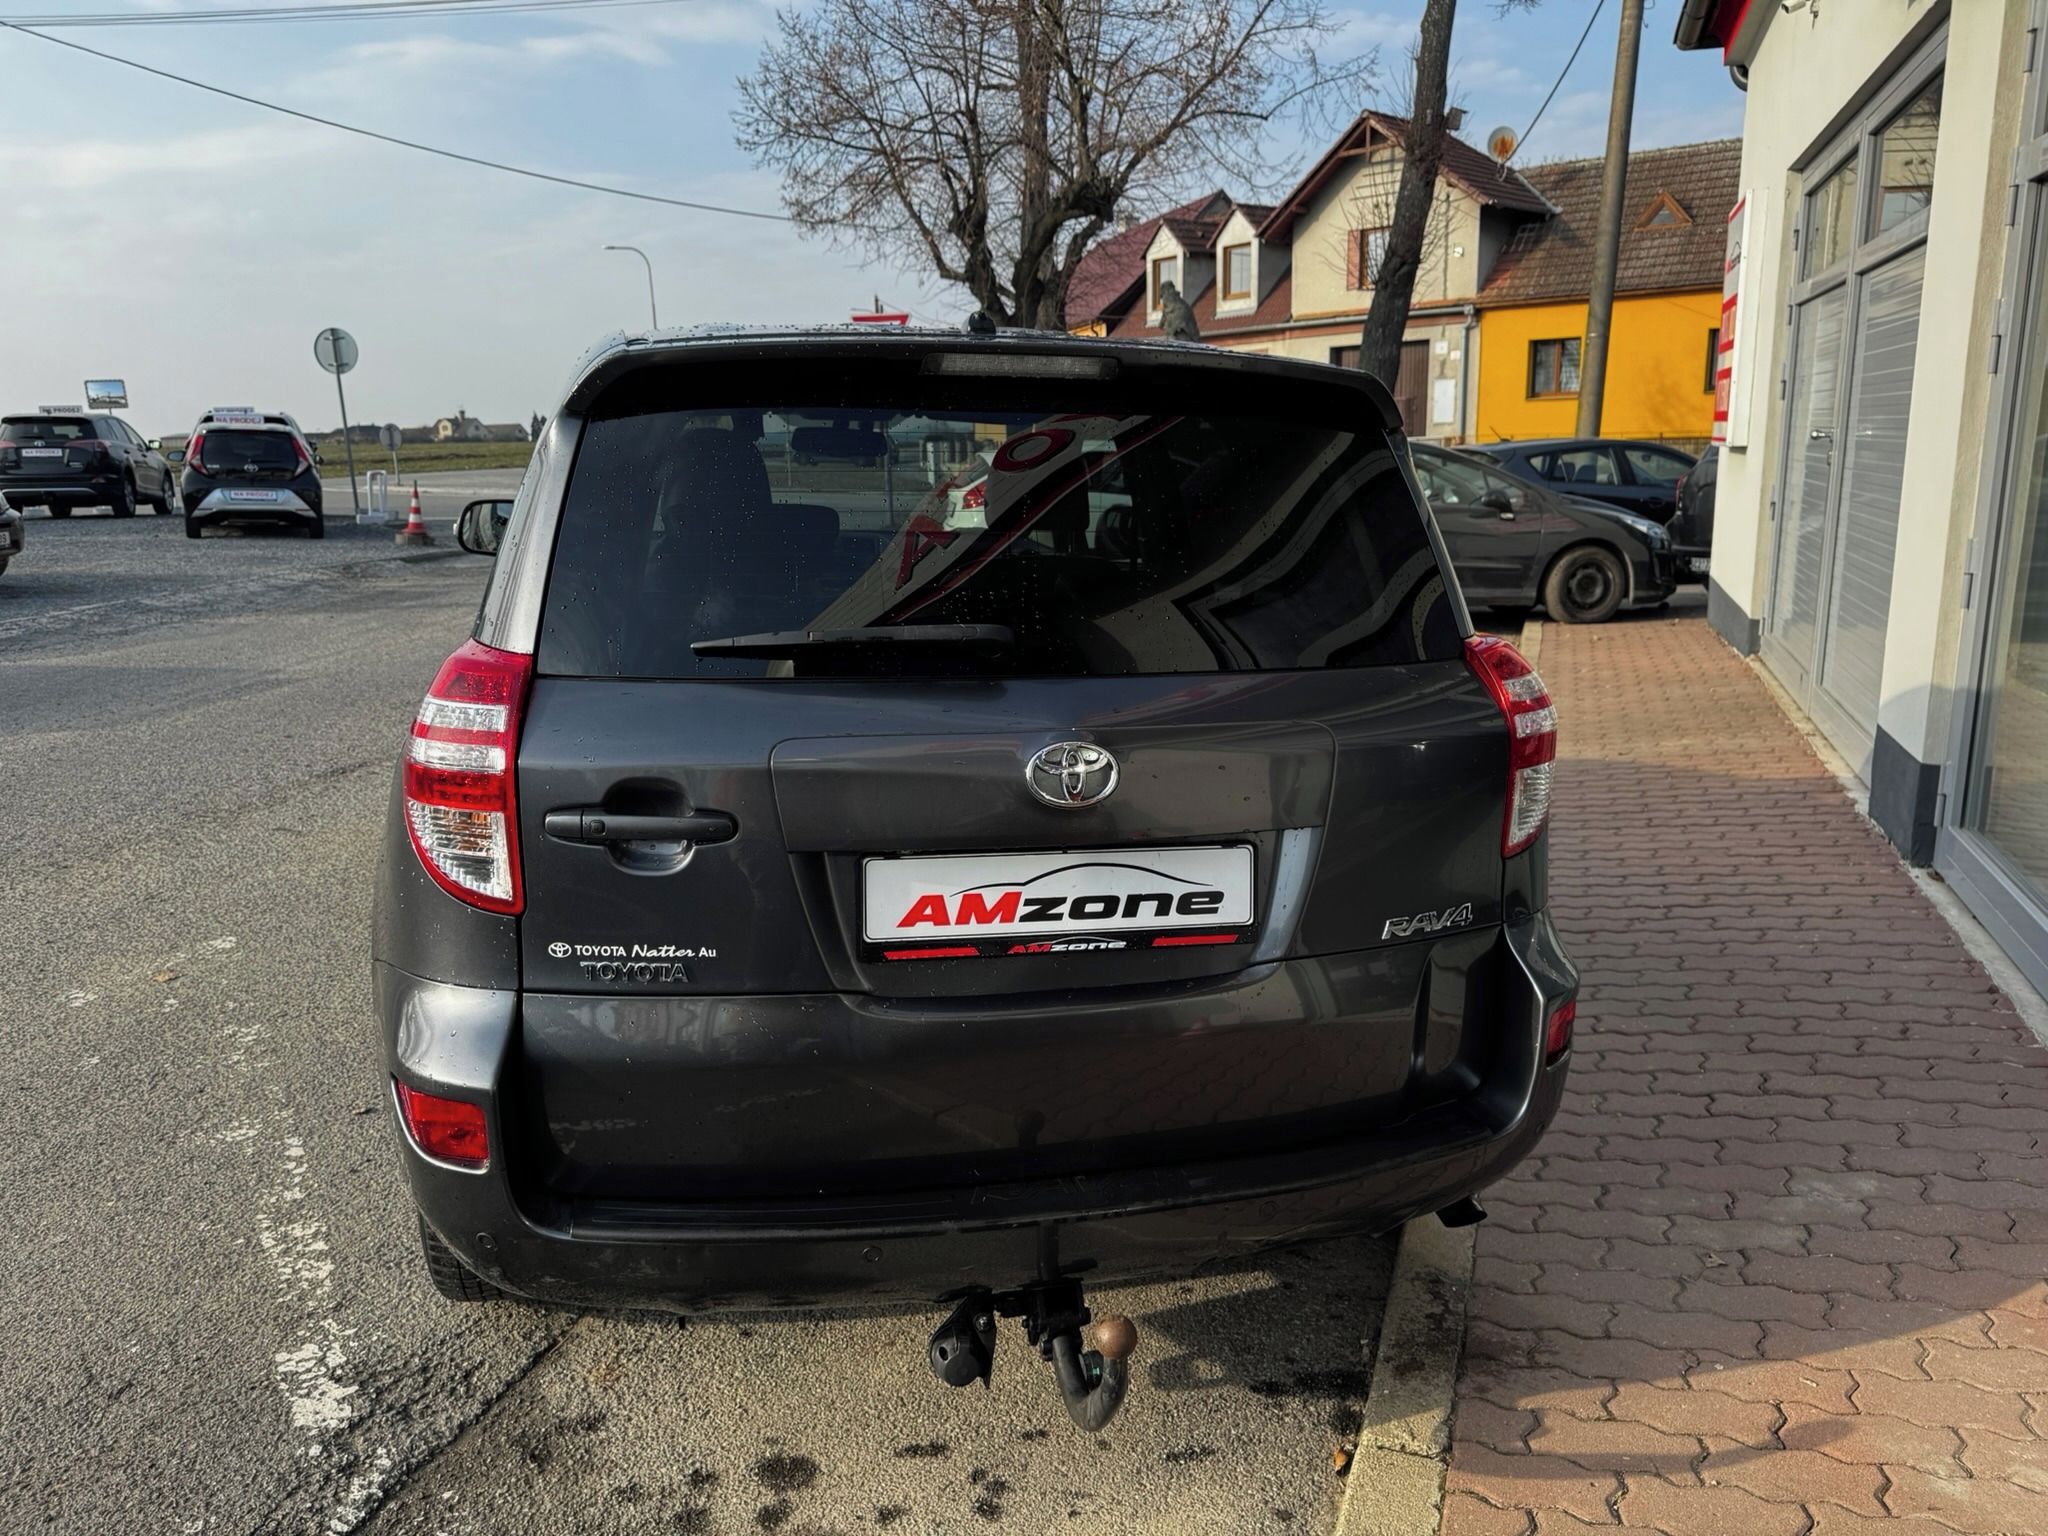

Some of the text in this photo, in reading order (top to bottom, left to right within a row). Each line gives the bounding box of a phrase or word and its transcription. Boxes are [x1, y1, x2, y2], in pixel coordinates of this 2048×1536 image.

[215, 417, 262, 425] NA PRODEJ
[896, 890, 1225, 928] AMzone
[1381, 902, 1473, 940] RAV4
[574, 944, 717, 958] TOYOTA Natter Au
[1008, 939, 1127, 954] AMzone
[580, 961, 689, 983] TOYOTA
